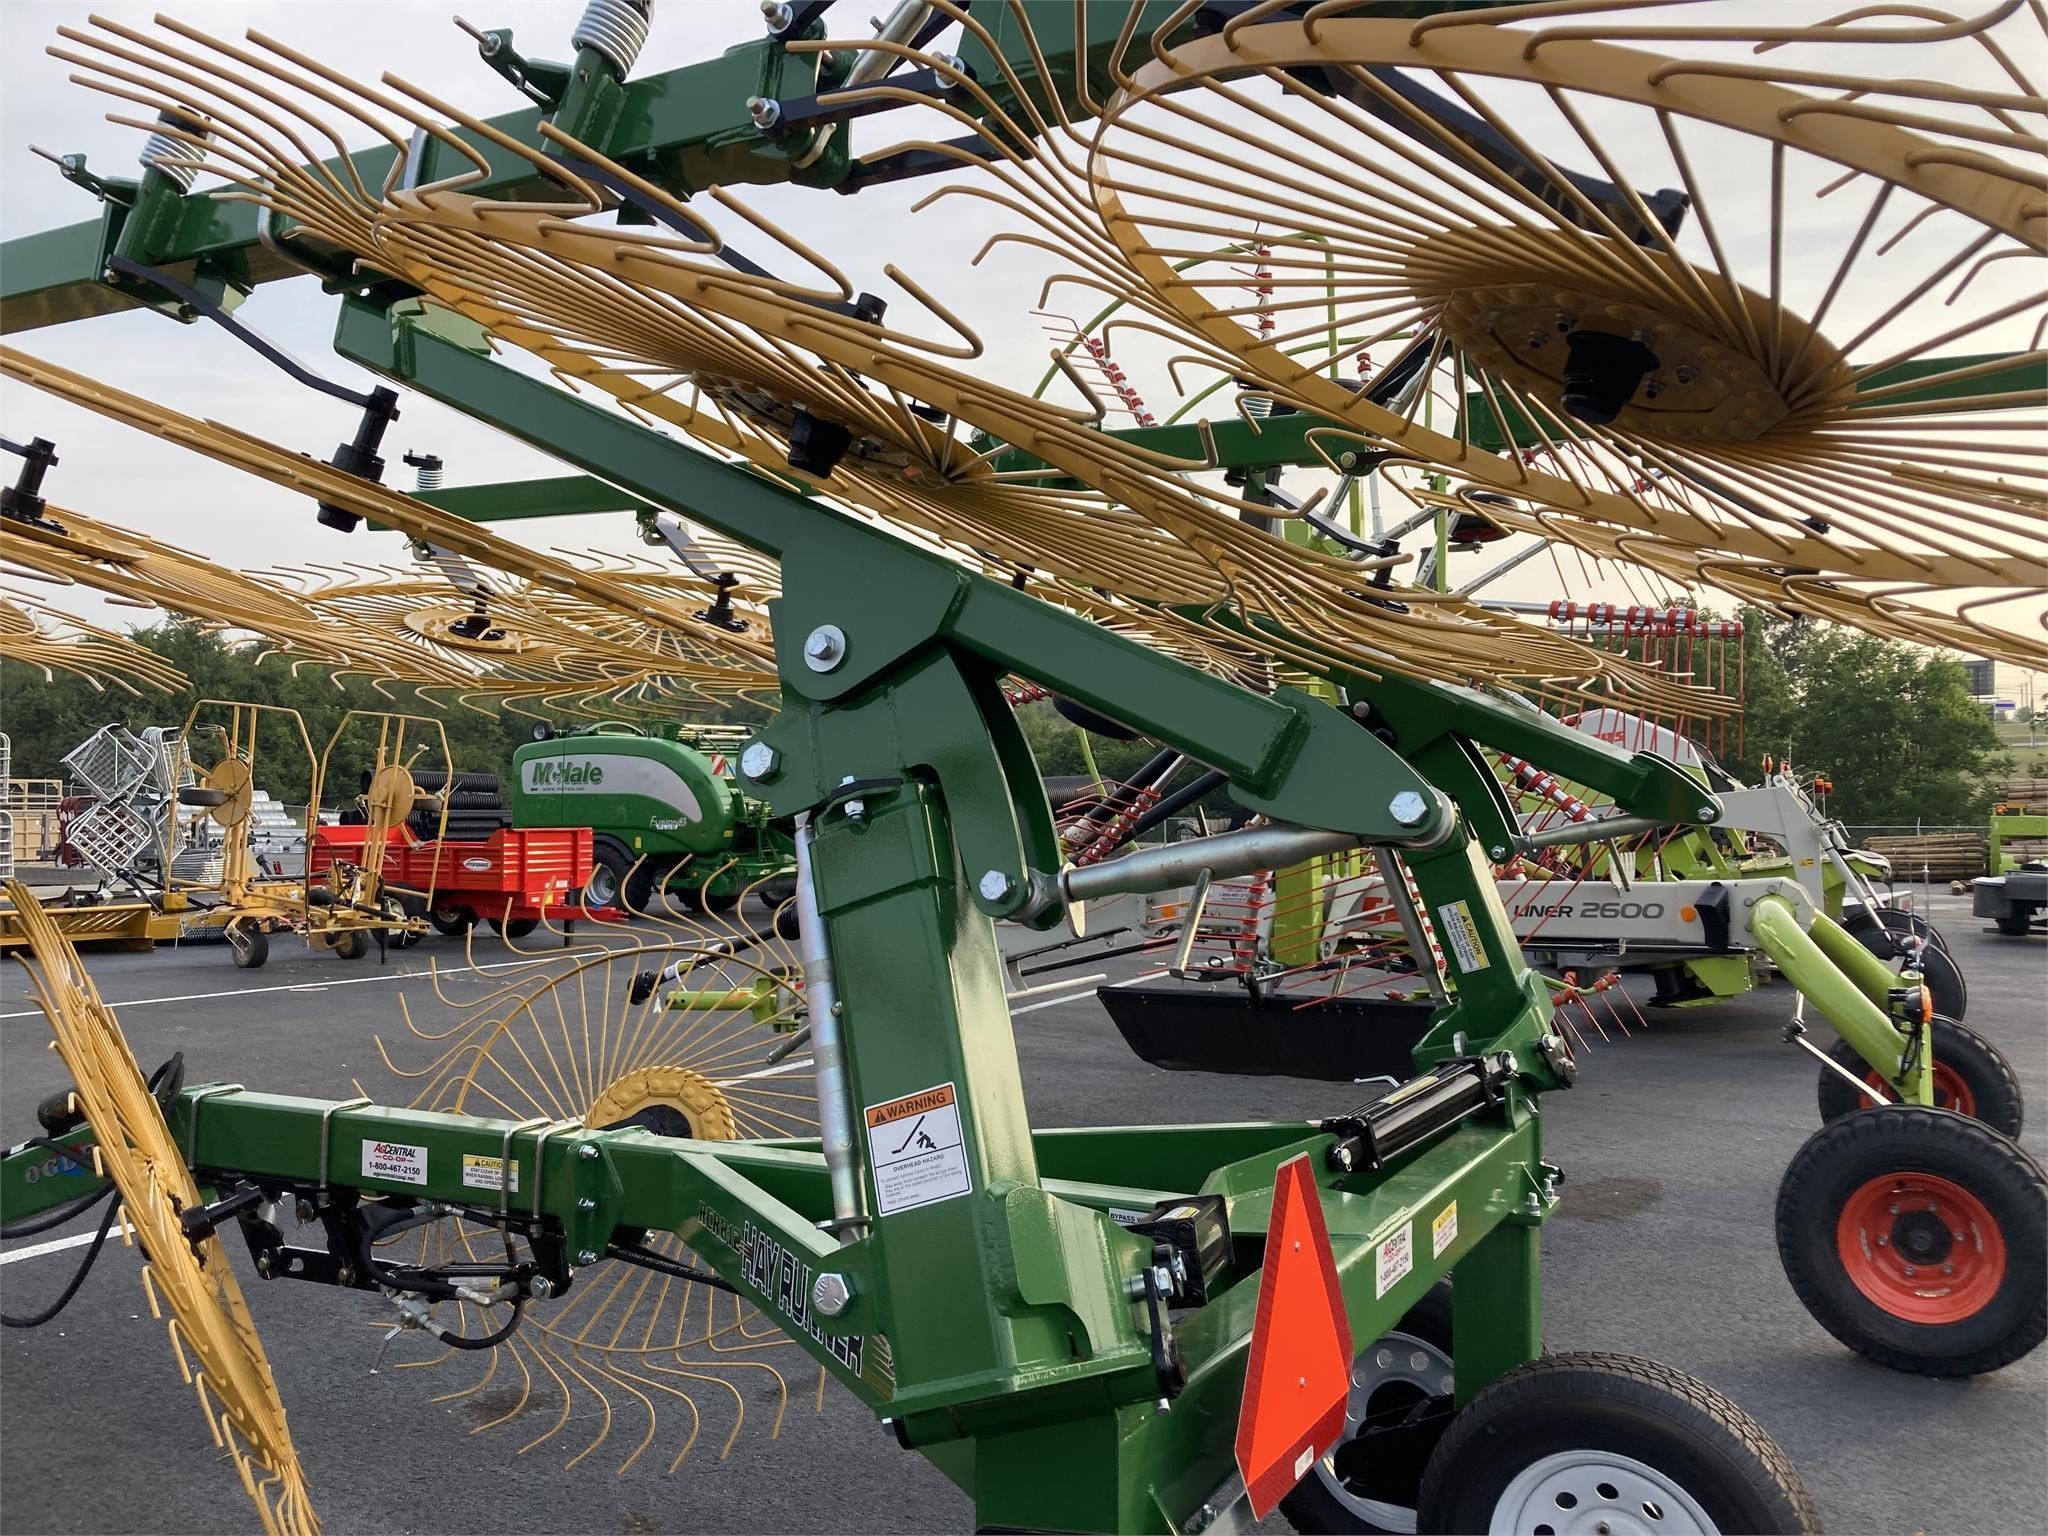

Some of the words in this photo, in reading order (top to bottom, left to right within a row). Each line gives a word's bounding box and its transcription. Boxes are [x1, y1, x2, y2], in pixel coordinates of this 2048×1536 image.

[1580, 902, 1665, 919] 2600
[1465, 923, 1483, 955] CAUTION
[887, 1092, 946, 1118] WARNING
[369, 1161, 420, 1175] 1-800-467-2150
[481, 1159, 503, 1169] CAUTIO
[893, 1159, 922, 1173] OVERHEAD
[922, 1154, 944, 1164] HAZARD
[1111, 1213, 1136, 1222] BYPASS
